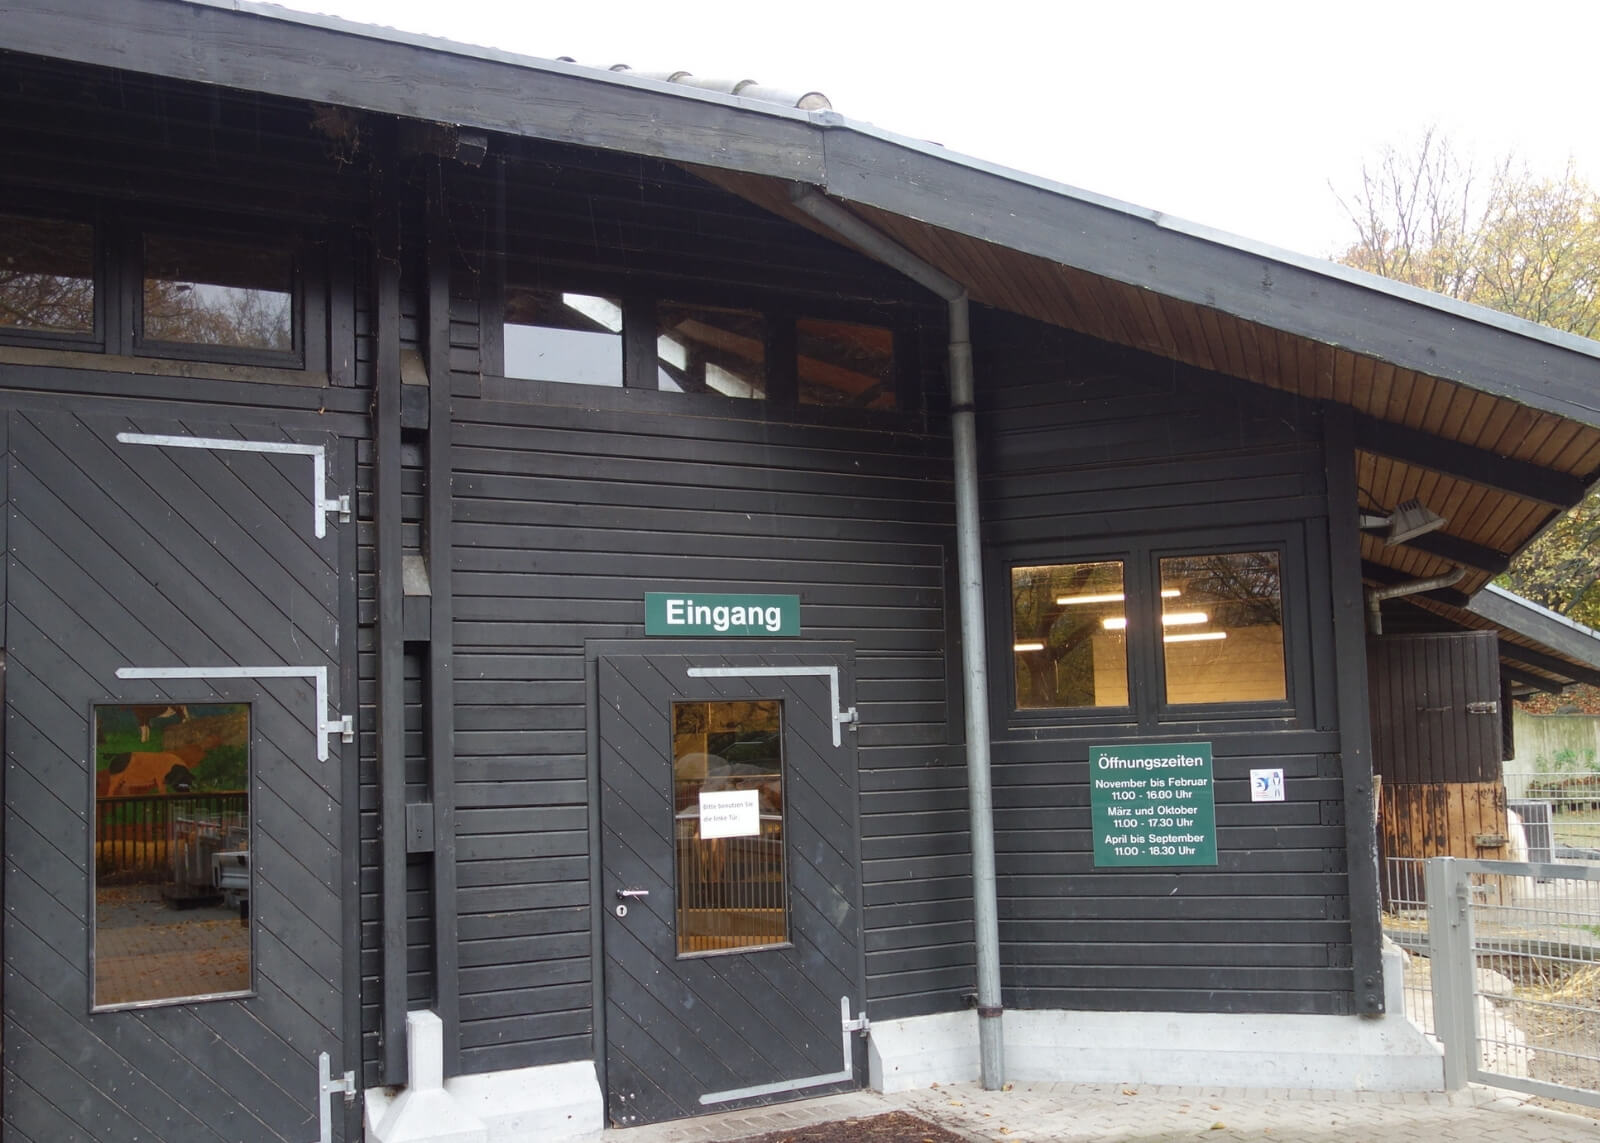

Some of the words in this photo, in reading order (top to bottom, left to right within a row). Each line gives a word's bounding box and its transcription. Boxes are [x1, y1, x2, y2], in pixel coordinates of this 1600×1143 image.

[666, 599, 781, 632] Eingang
[1098, 753, 1203, 770] Öffnungszeiten
[1095, 779, 1146, 789] November
[1150, 778, 1165, 787] bis
[1168, 777, 1208, 787] Februar
[1111, 790, 1136, 800] 11.00
[1175, 789, 1193, 799] Uhr
[1107, 806, 1132, 816] März
[1135, 806, 1154, 815] und
[1157, 805, 1198, 815] Oktober
[1113, 818, 1138, 828] 11.00
[1147, 818, 1173, 827] 17.30
[1176, 817, 1194, 827] Uhr
[1104, 834, 1127, 845] April
[1130, 834, 1145, 844] bis
[1148, 833, 1204, 845] September
[1114, 847, 1139, 856] 11.00
[1148, 846, 1176, 855] 18.30
[1178, 845, 1196, 855] Uhr
